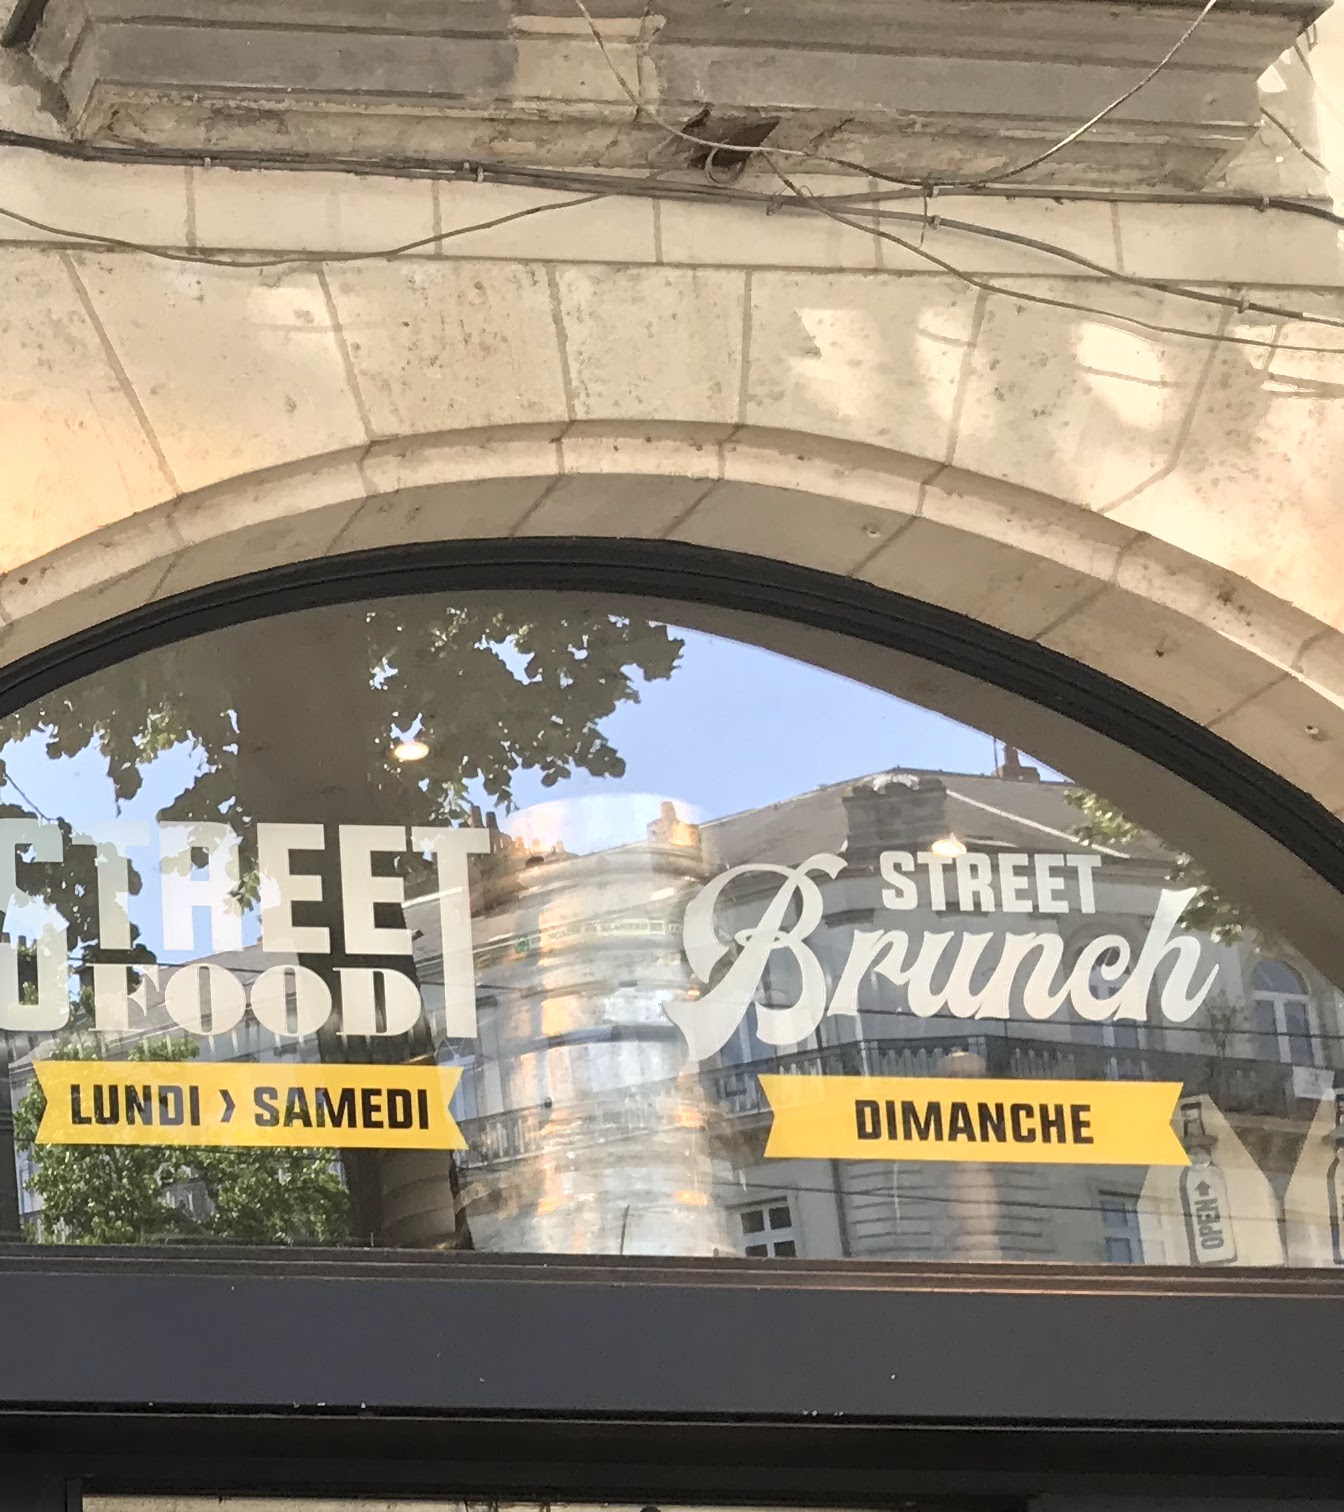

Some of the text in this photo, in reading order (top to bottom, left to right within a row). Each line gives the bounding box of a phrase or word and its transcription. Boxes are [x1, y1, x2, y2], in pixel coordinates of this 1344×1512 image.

[881, 851, 1102, 913] STREET
[663, 852, 1221, 1062] Brunch
[87, 962, 422, 1037] FOOD
[70, 1083, 430, 1131] LUNDI SAMEDI
[854, 1099, 1095, 1146] DIMANCHE
[1194, 1198, 1225, 1250] OPEN
